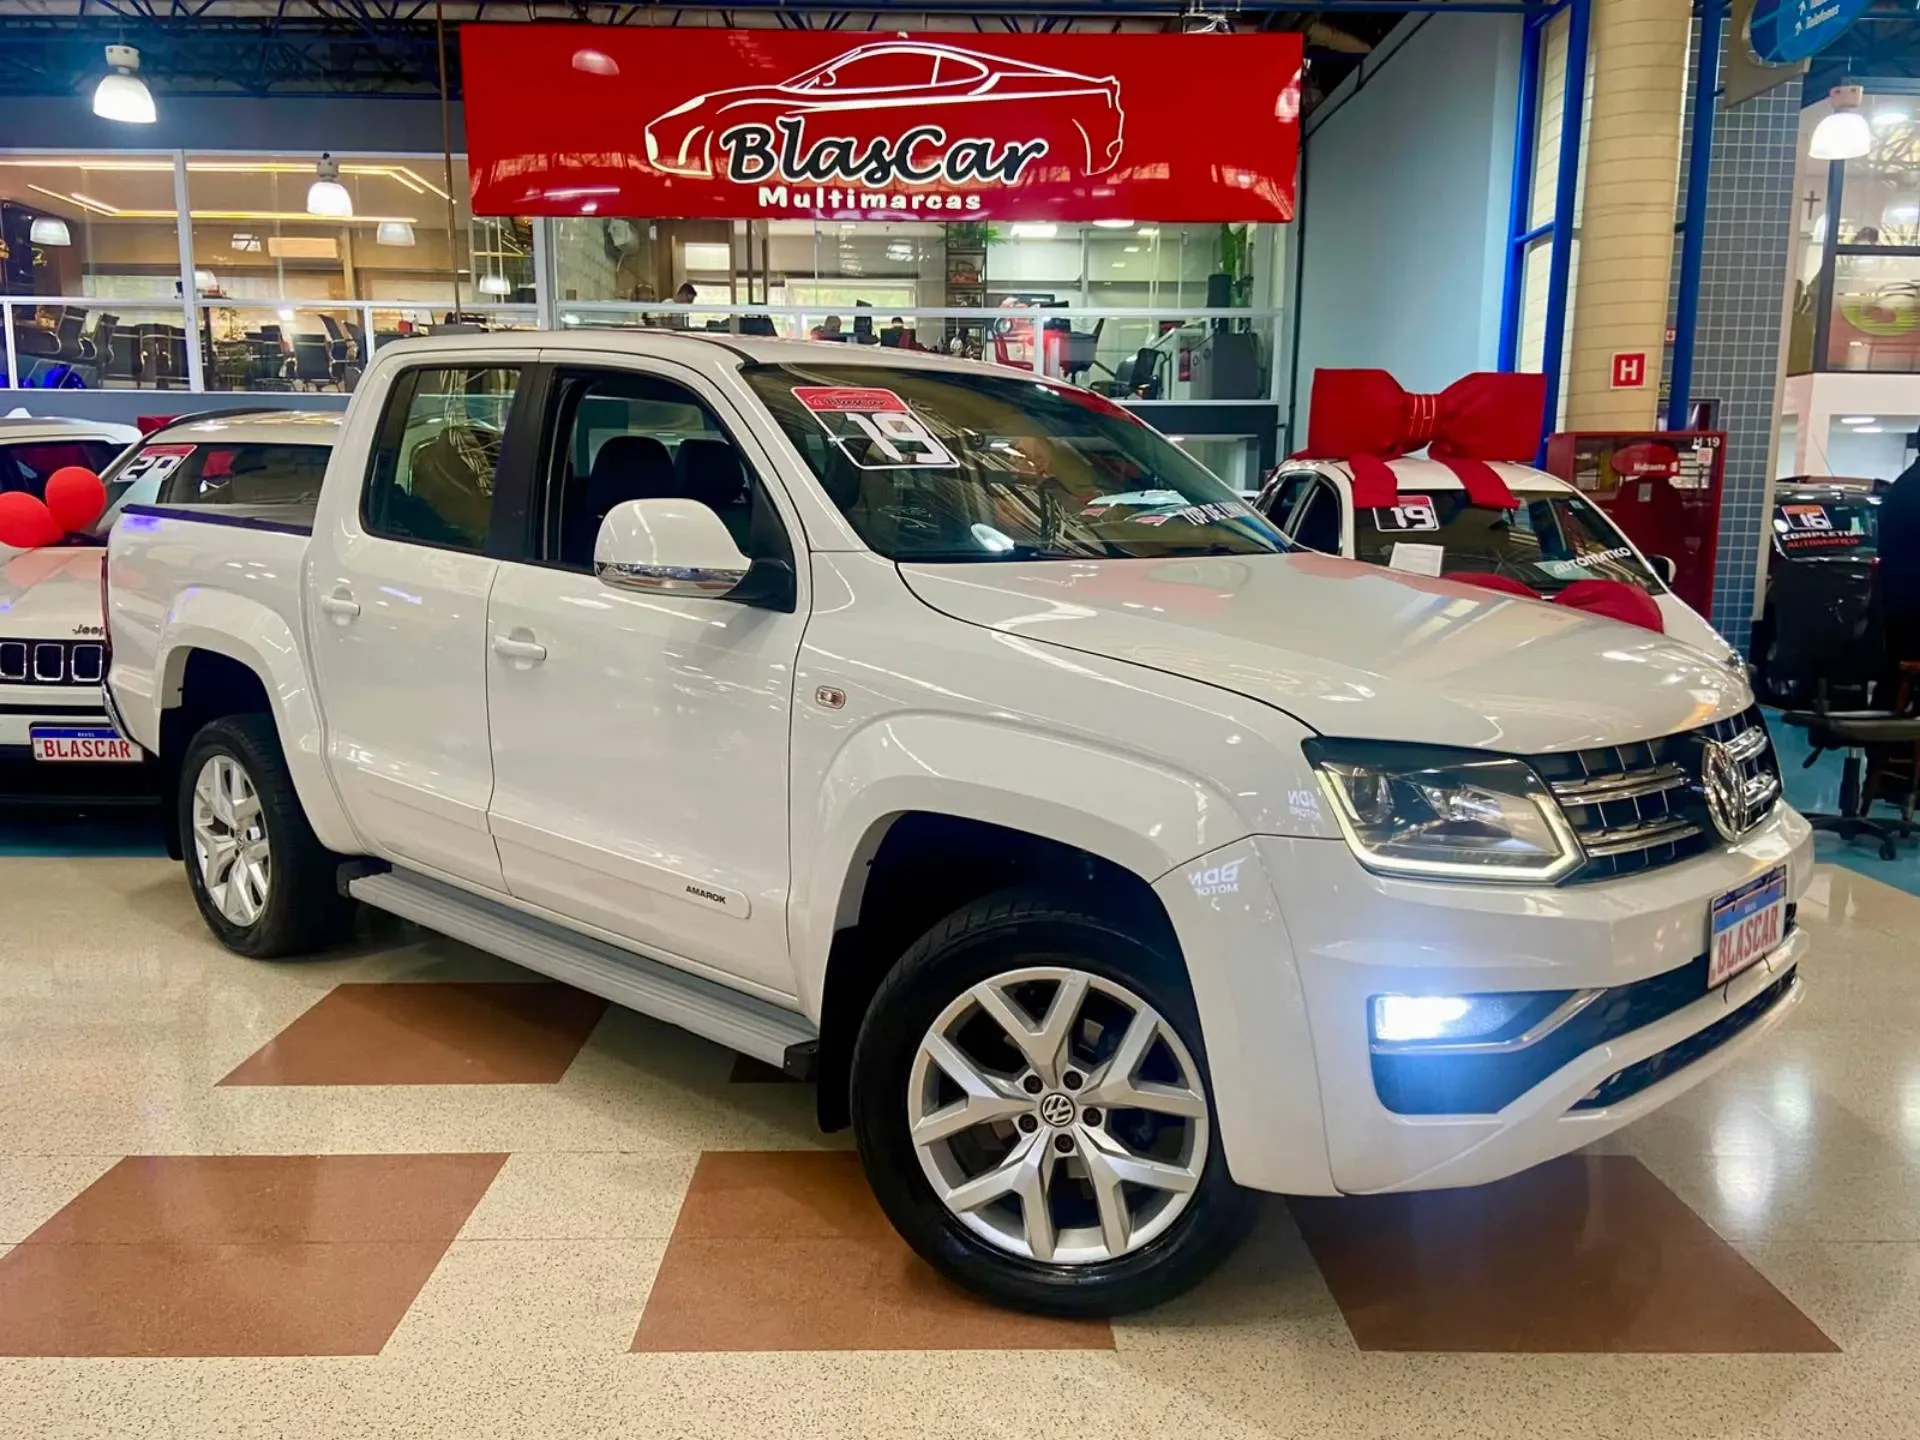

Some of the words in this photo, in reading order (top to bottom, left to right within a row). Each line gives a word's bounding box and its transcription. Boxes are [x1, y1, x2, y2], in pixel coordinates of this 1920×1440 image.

[719, 115, 1049, 189] BlasCar
[758, 186, 982, 211] Multimarcas
[1620, 359, 1638, 381] H
[1391, 506, 1437, 528] 19
[1799, 512, 1828, 528] 16
[43, 739, 131, 758] BLASCAR
[685, 885, 726, 904] AMAROK
[1717, 905, 1778, 974] BLASCAR
